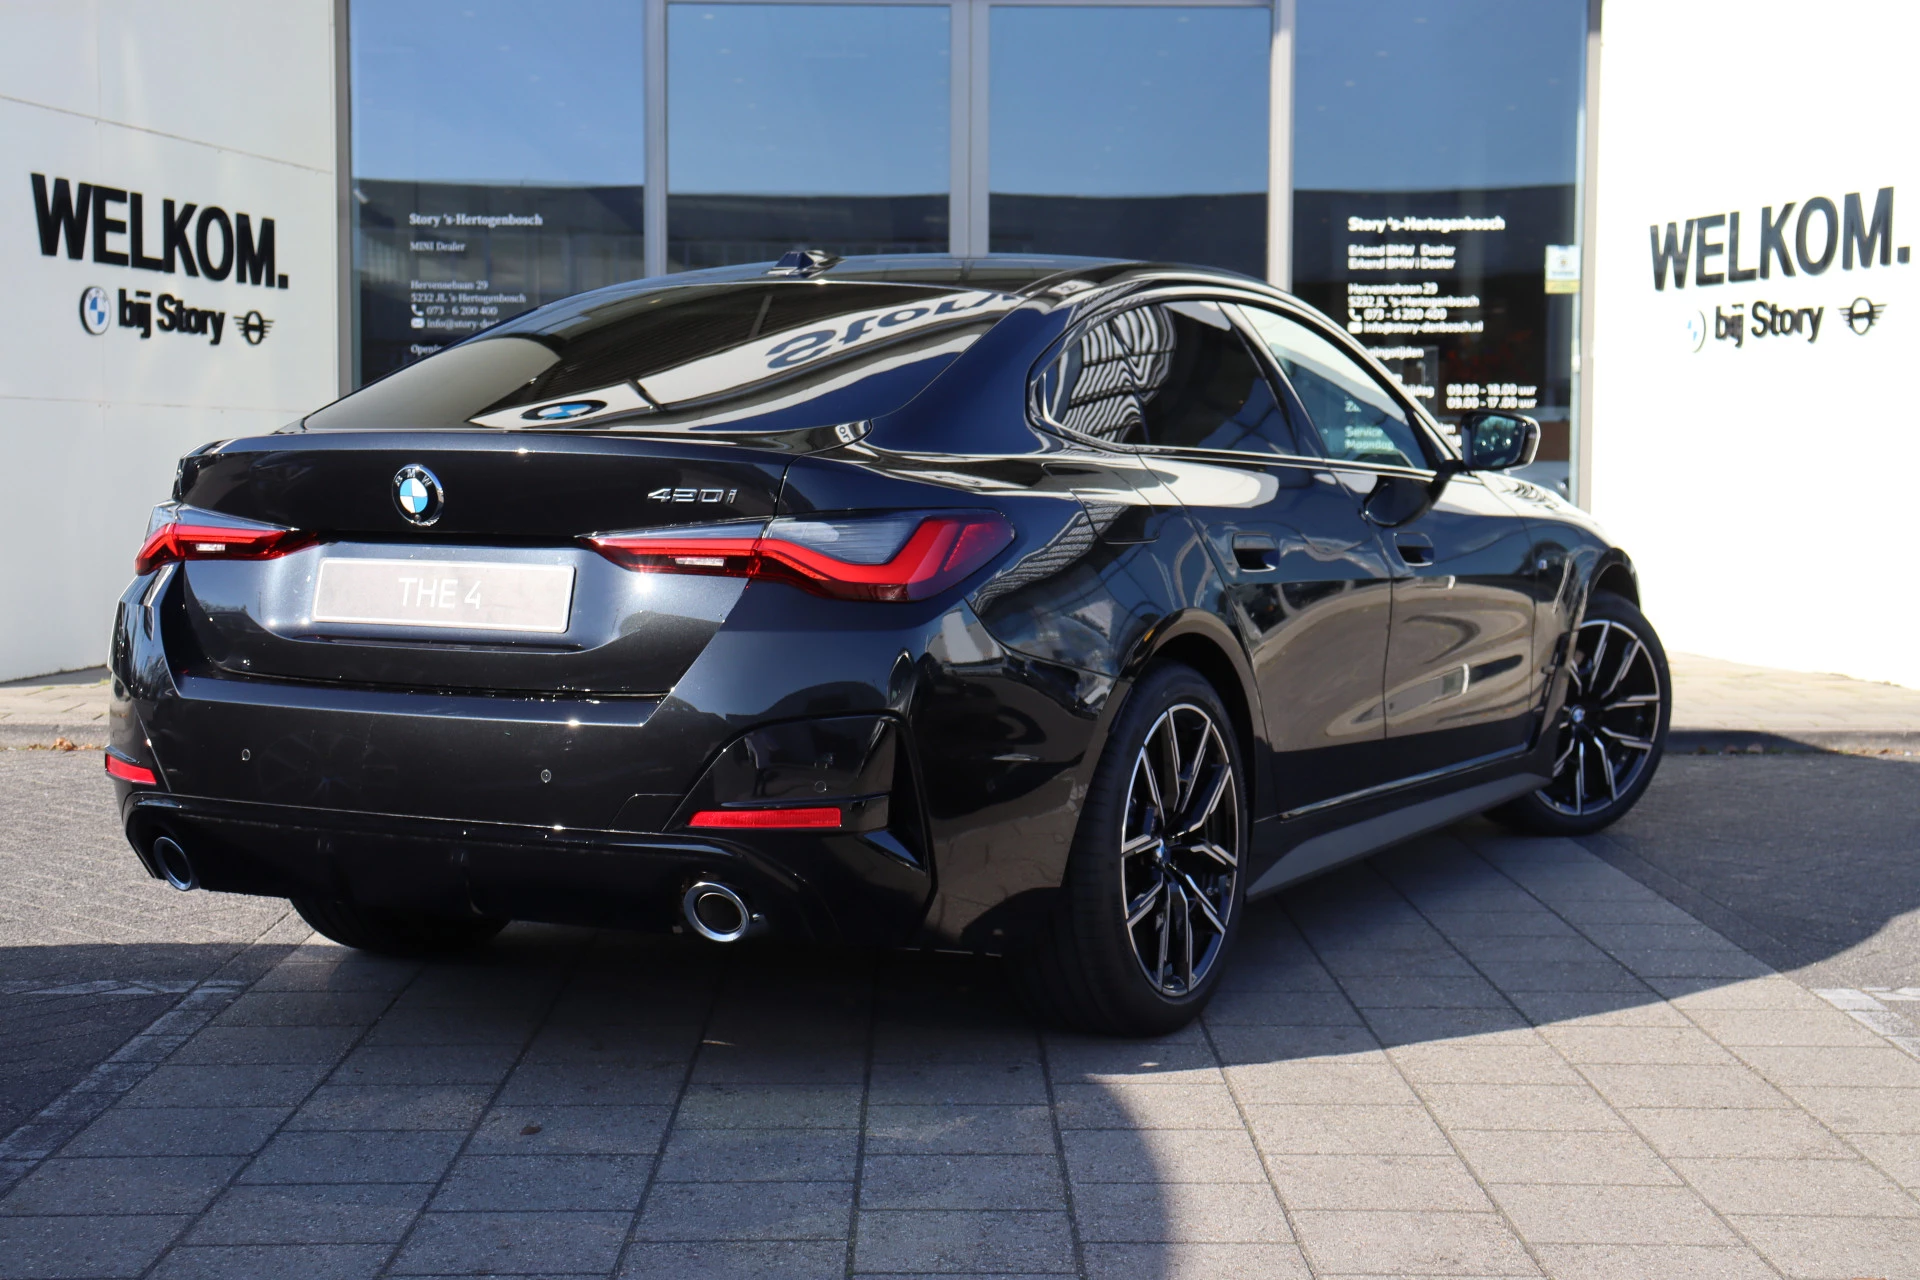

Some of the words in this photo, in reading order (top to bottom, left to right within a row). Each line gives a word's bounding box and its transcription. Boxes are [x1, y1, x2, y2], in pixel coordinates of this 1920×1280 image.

[409, 213, 441, 228] Story
[1348, 216, 1387, 234] Story
[30, 172, 289, 290] WELKOM.
[1650, 186, 1911, 292] WELKOM.
[409, 241, 434, 252] MINI
[436, 241, 466, 252] Dealer
[1348, 244, 1385, 257] Erkend
[1386, 244, 1416, 257] BMW
[1420, 244, 1457, 257] Dealer
[1348, 257, 1385, 270] Erkend
[1386, 257, 1415, 270] BMW
[1420, 257, 1457, 270] Dealer
[476, 281, 489, 291] 29
[1423, 281, 1439, 295] 29
[1348, 295, 1375, 308] 5232
[118, 288, 152, 339] bij
[157, 293, 226, 345] Story
[426, 306, 445, 316] 073
[460, 306, 478, 316] 200
[479, 306, 498, 316] 400
[1363, 308, 1384, 320] 073
[1401, 308, 1424, 320] 200
[1424, 308, 1447, 320] 400
[1715, 303, 1744, 349] bij
[1751, 300, 1824, 344] Story
[1446, 383, 1480, 396] 09.00
[1486, 383, 1518, 396] 18.00
[1518, 385, 1538, 396] uur
[1446, 396, 1480, 410] 09.00
[1486, 396, 1518, 410] 17.00
[1518, 398, 1538, 409] uur
[1344, 425, 1383, 438] Service
[1344, 439, 1395, 451] Maandag
[647, 488, 738, 504] 420i
[398, 577, 459, 609] THE
[463, 579, 482, 610] 4
